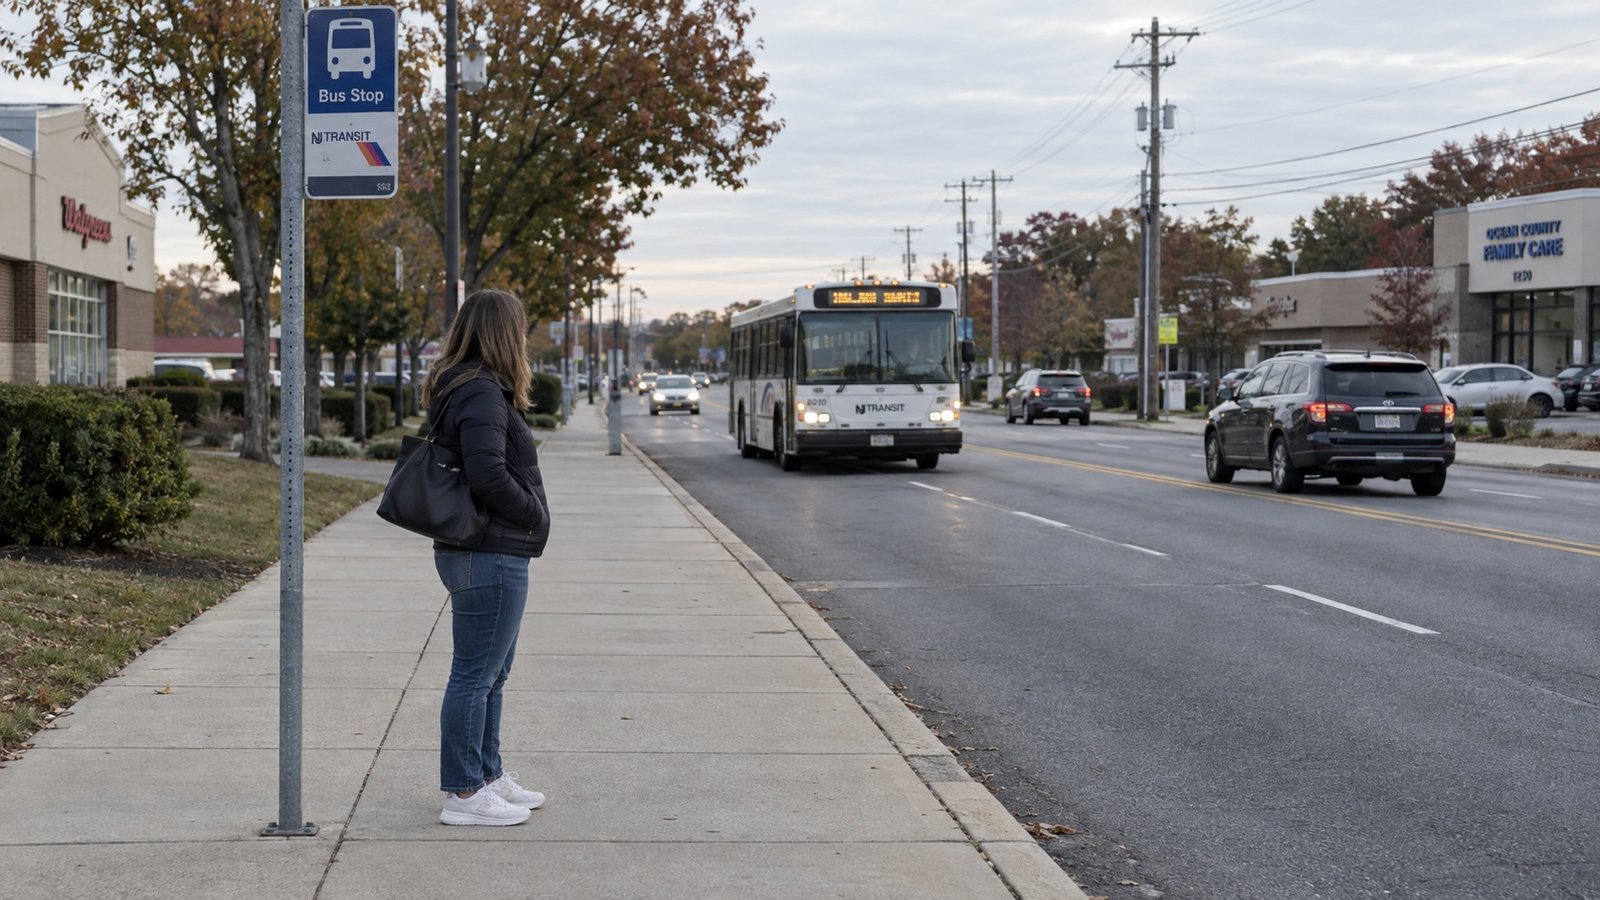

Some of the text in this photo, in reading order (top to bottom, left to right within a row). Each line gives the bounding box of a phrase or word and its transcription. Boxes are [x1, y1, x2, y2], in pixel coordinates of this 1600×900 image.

[319, 88, 384, 104] Bus Stop
[324, 131, 371, 141] TRANSIT
[61, 195, 112, 249] Walgreens
[1487, 220, 1561, 240] OCEAN COUNTY
[1484, 238, 1563, 261] FAMILY CARE
[866, 403, 905, 412] TRANSIT
